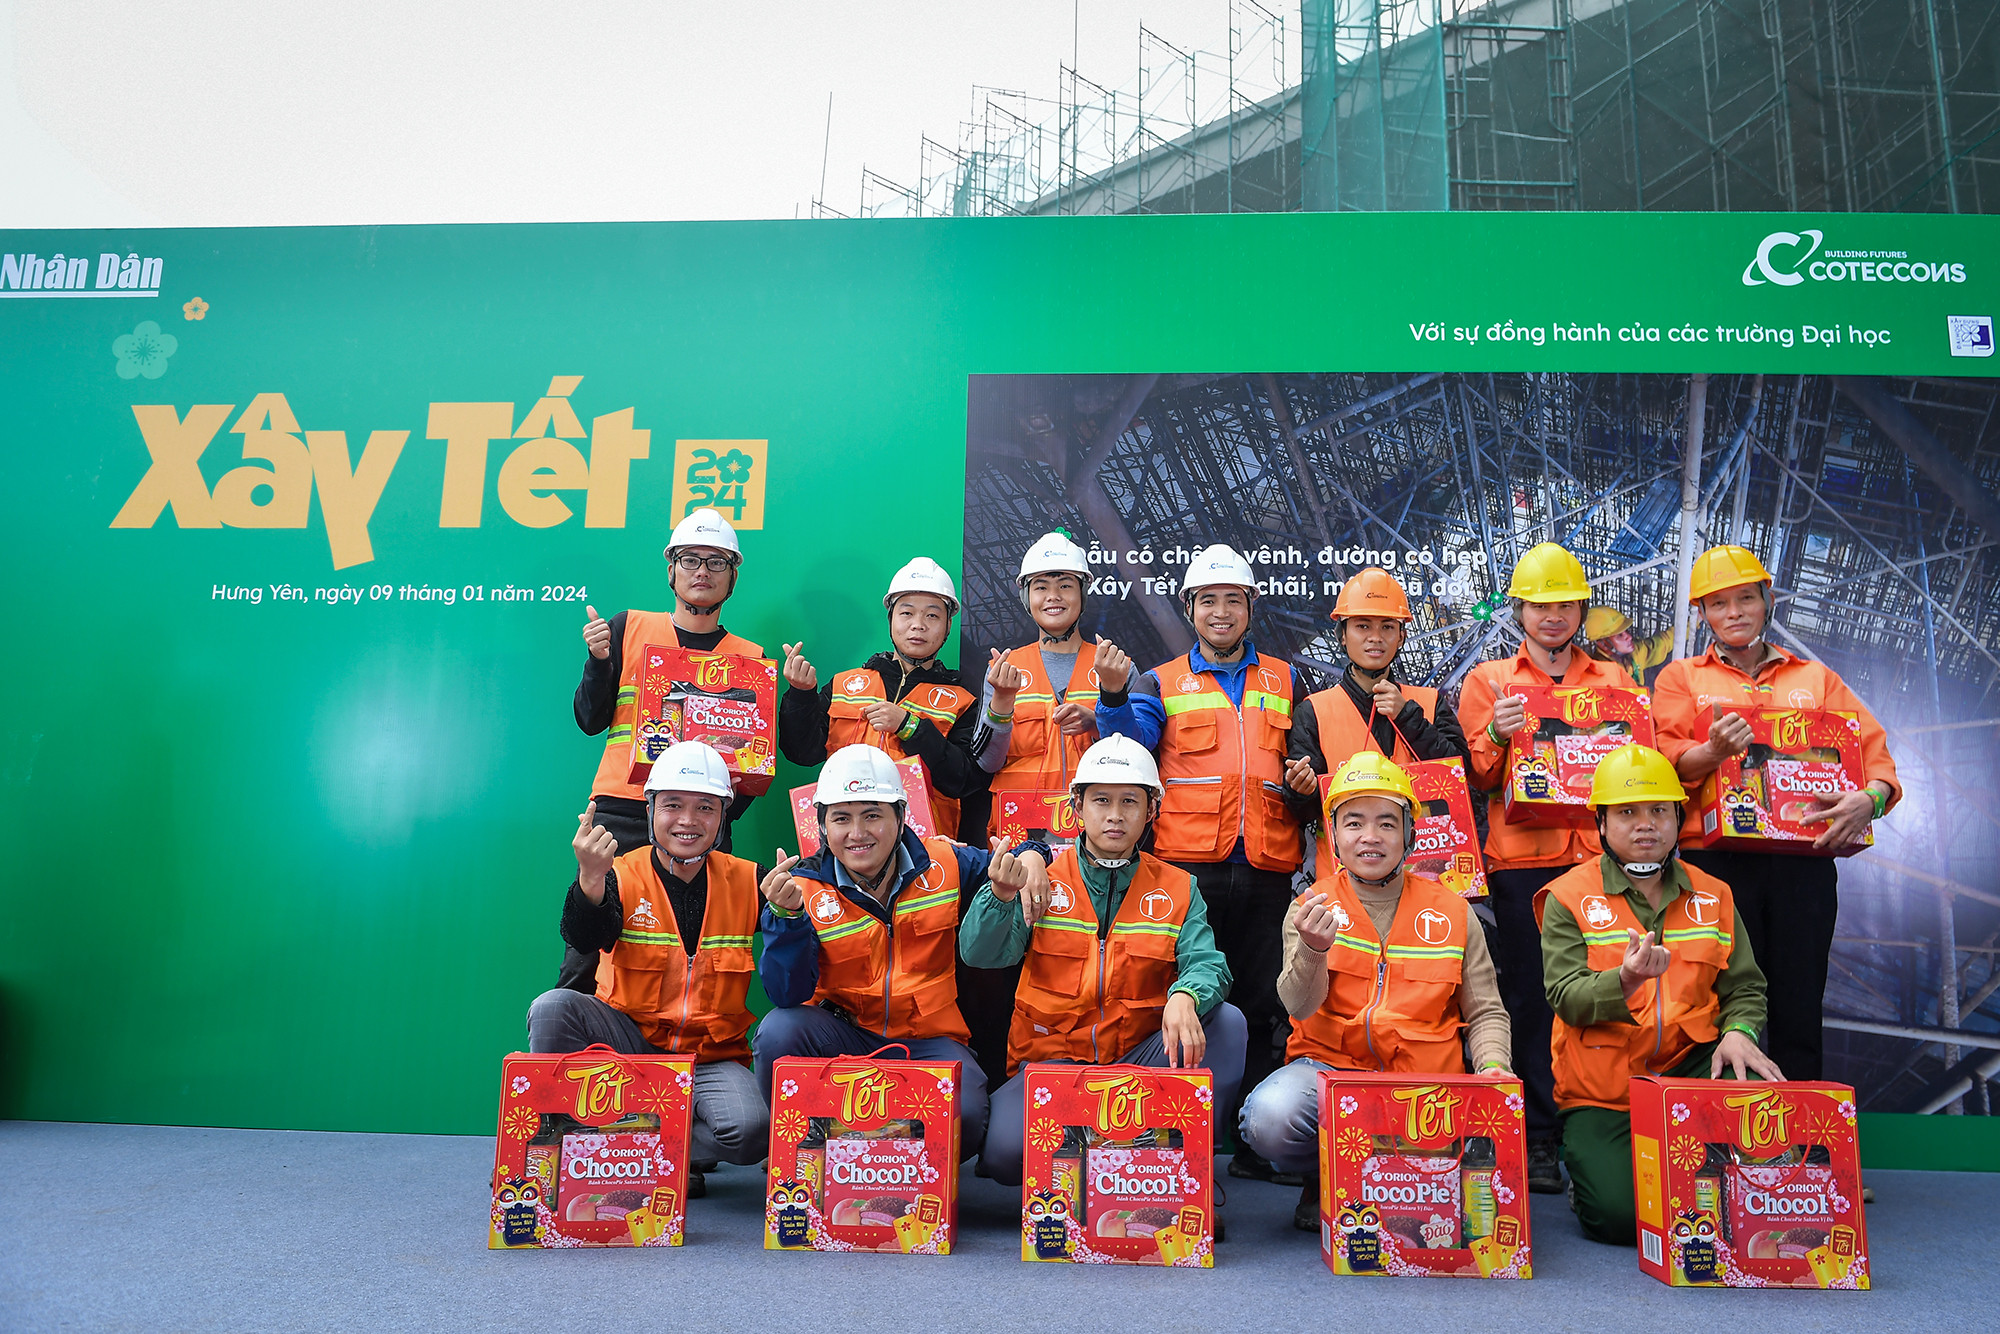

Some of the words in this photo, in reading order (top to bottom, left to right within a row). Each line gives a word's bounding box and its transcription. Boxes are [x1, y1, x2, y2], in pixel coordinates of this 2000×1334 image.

[1825, 250, 1868, 258] BUILDING
[1870, 250, 1907, 258] FUTURES
[0, 253, 88, 289] Nhân
[95, 253, 163, 288] Dân
[1409, 322, 1445, 341] Với
[1454, 325, 1479, 345] sự
[1487, 319, 1545, 346] đồng
[1554, 323, 1610, 341] hành
[1619, 322, 1660, 341] của
[1668, 323, 1708, 342] các
[1716, 324, 1793, 347] trường
[1802, 325, 1840, 347] Đại
[1849, 325, 1890, 348] học
[109, 393, 411, 570] Xây
[426, 376, 651, 528] Tết
[1085, 540, 1117, 564] ẫu
[1126, 544, 1154, 564] có
[1162, 545, 1203, 564] chê
[1243, 545, 1309, 569] vênh,
[1318, 545, 1396, 569] đường
[1405, 546, 1434, 564] có
[212, 585, 262, 604] Hưng
[270, 584, 308, 603] Yên,
[315, 584, 364, 604] ngày
[370, 585, 393, 601] 09
[399, 584, 456, 605] tháng
[463, 585, 484, 601] 01
[491, 585, 534, 601] năm
[541, 586, 588, 602] 2024
[1087, 575, 1132, 600] Xây
[1141, 572, 1177, 595] Tết
[1258, 576, 1314, 599] chãi,
[689, 655, 734, 686] Tết
[1554, 688, 1604, 721] Tết
[692, 710, 753, 729] ChocoP
[1762, 710, 1813, 748] Tết
[567, 1062, 632, 1117] Tết
[832, 1068, 895, 1122] Tết
[1086, 1075, 1152, 1131] Tết
[1393, 1084, 1460, 1140] Tết
[1725, 1089, 1793, 1148] Tết
[612, 1149, 646, 1157] ORION
[873, 1155, 907, 1164] ORION
[568, 1157, 655, 1179] ChocoP
[1137, 1165, 1172, 1174] ORION
[1384, 1172, 1419, 1182] ORION
[1361, 1180, 1450, 1204] hocoPie
[1787, 1184, 1822, 1193] ORION
[1425, 1224, 1451, 1241] Đào
